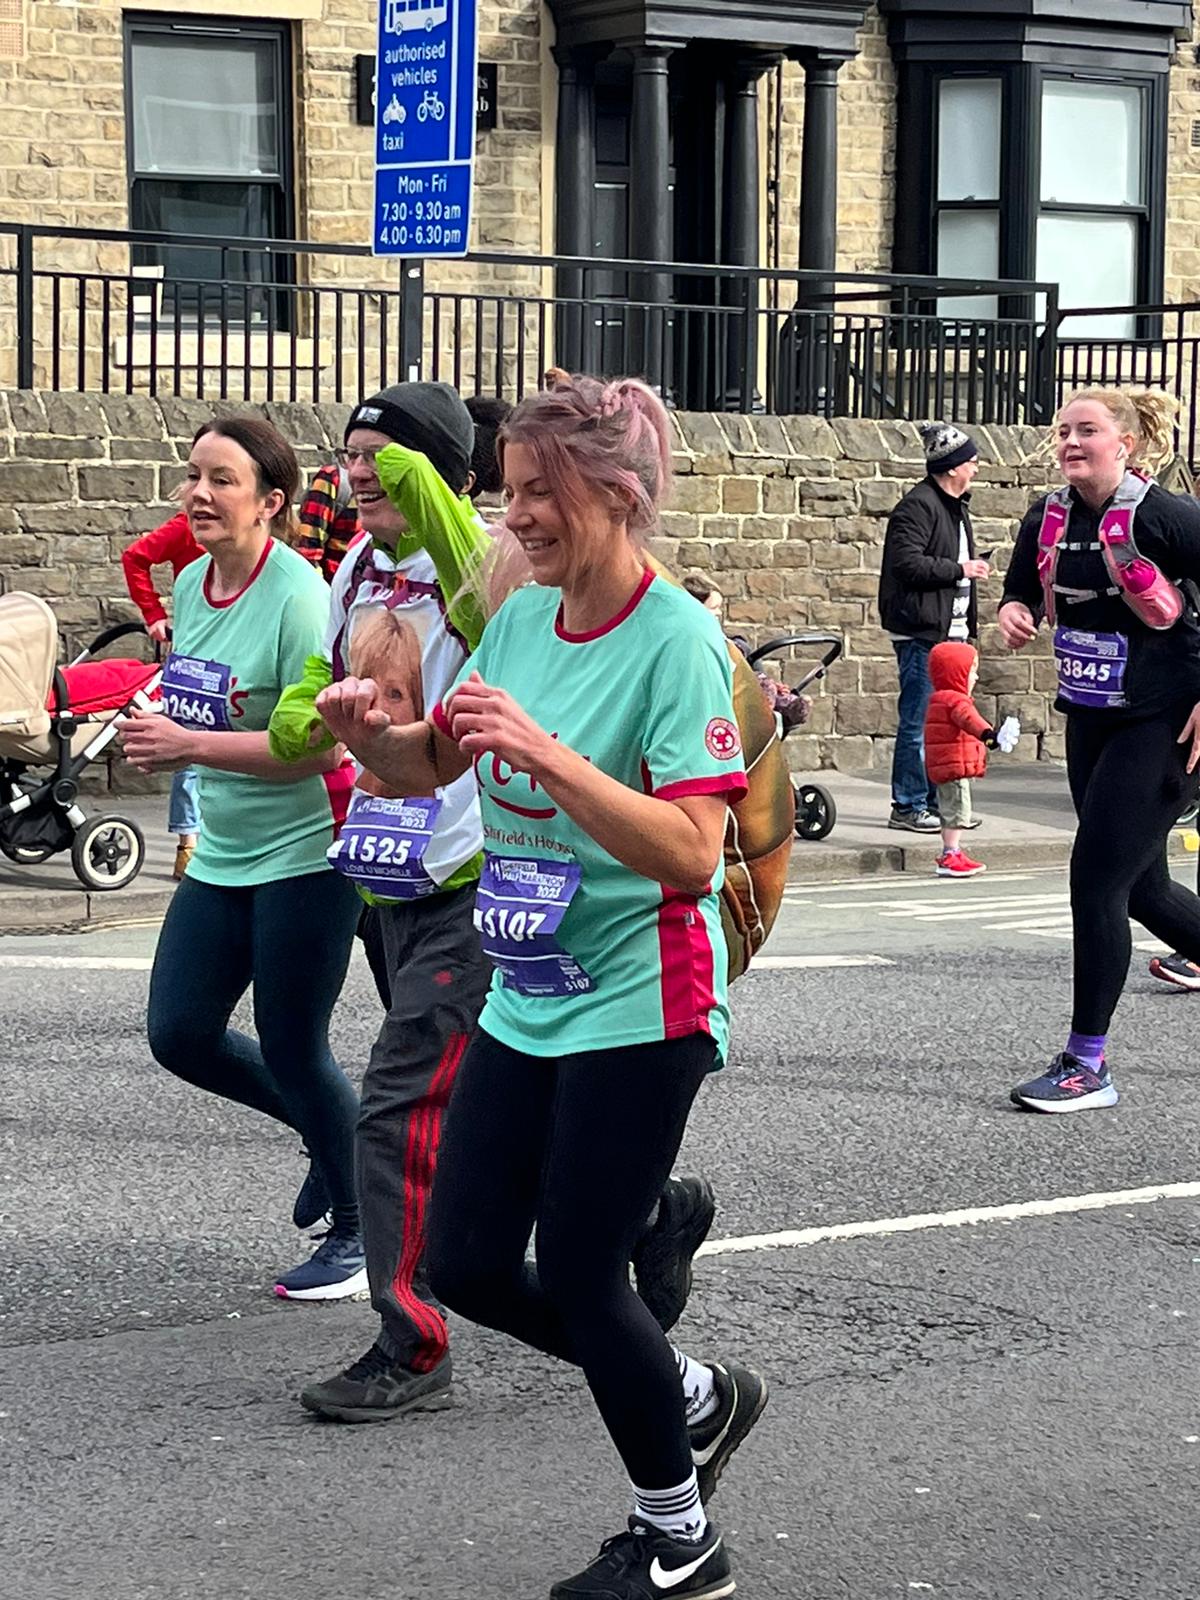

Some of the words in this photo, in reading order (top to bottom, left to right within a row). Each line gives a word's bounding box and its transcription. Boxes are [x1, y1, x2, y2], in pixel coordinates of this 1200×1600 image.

[385, 41, 446, 64] authorised
[391, 66, 437, 87] vehicles
[383, 131, 404, 151] taxi
[398, 175, 423, 194] Mon
[431, 173, 448, 193] Fri
[381, 202, 408, 222] 7.30
[415, 201, 442, 220] 9.30
[444, 205, 461, 220] am
[380, 226, 408, 245] 4.00
[415, 225, 442, 244] 6.30
[444, 229, 461, 247] pm
[1062, 657, 1111, 682] 3845
[168, 694, 216, 726] 2666
[400, 816, 427, 829] 2023
[348, 835, 413, 865] 1525
[484, 907, 547, 942] 5107
